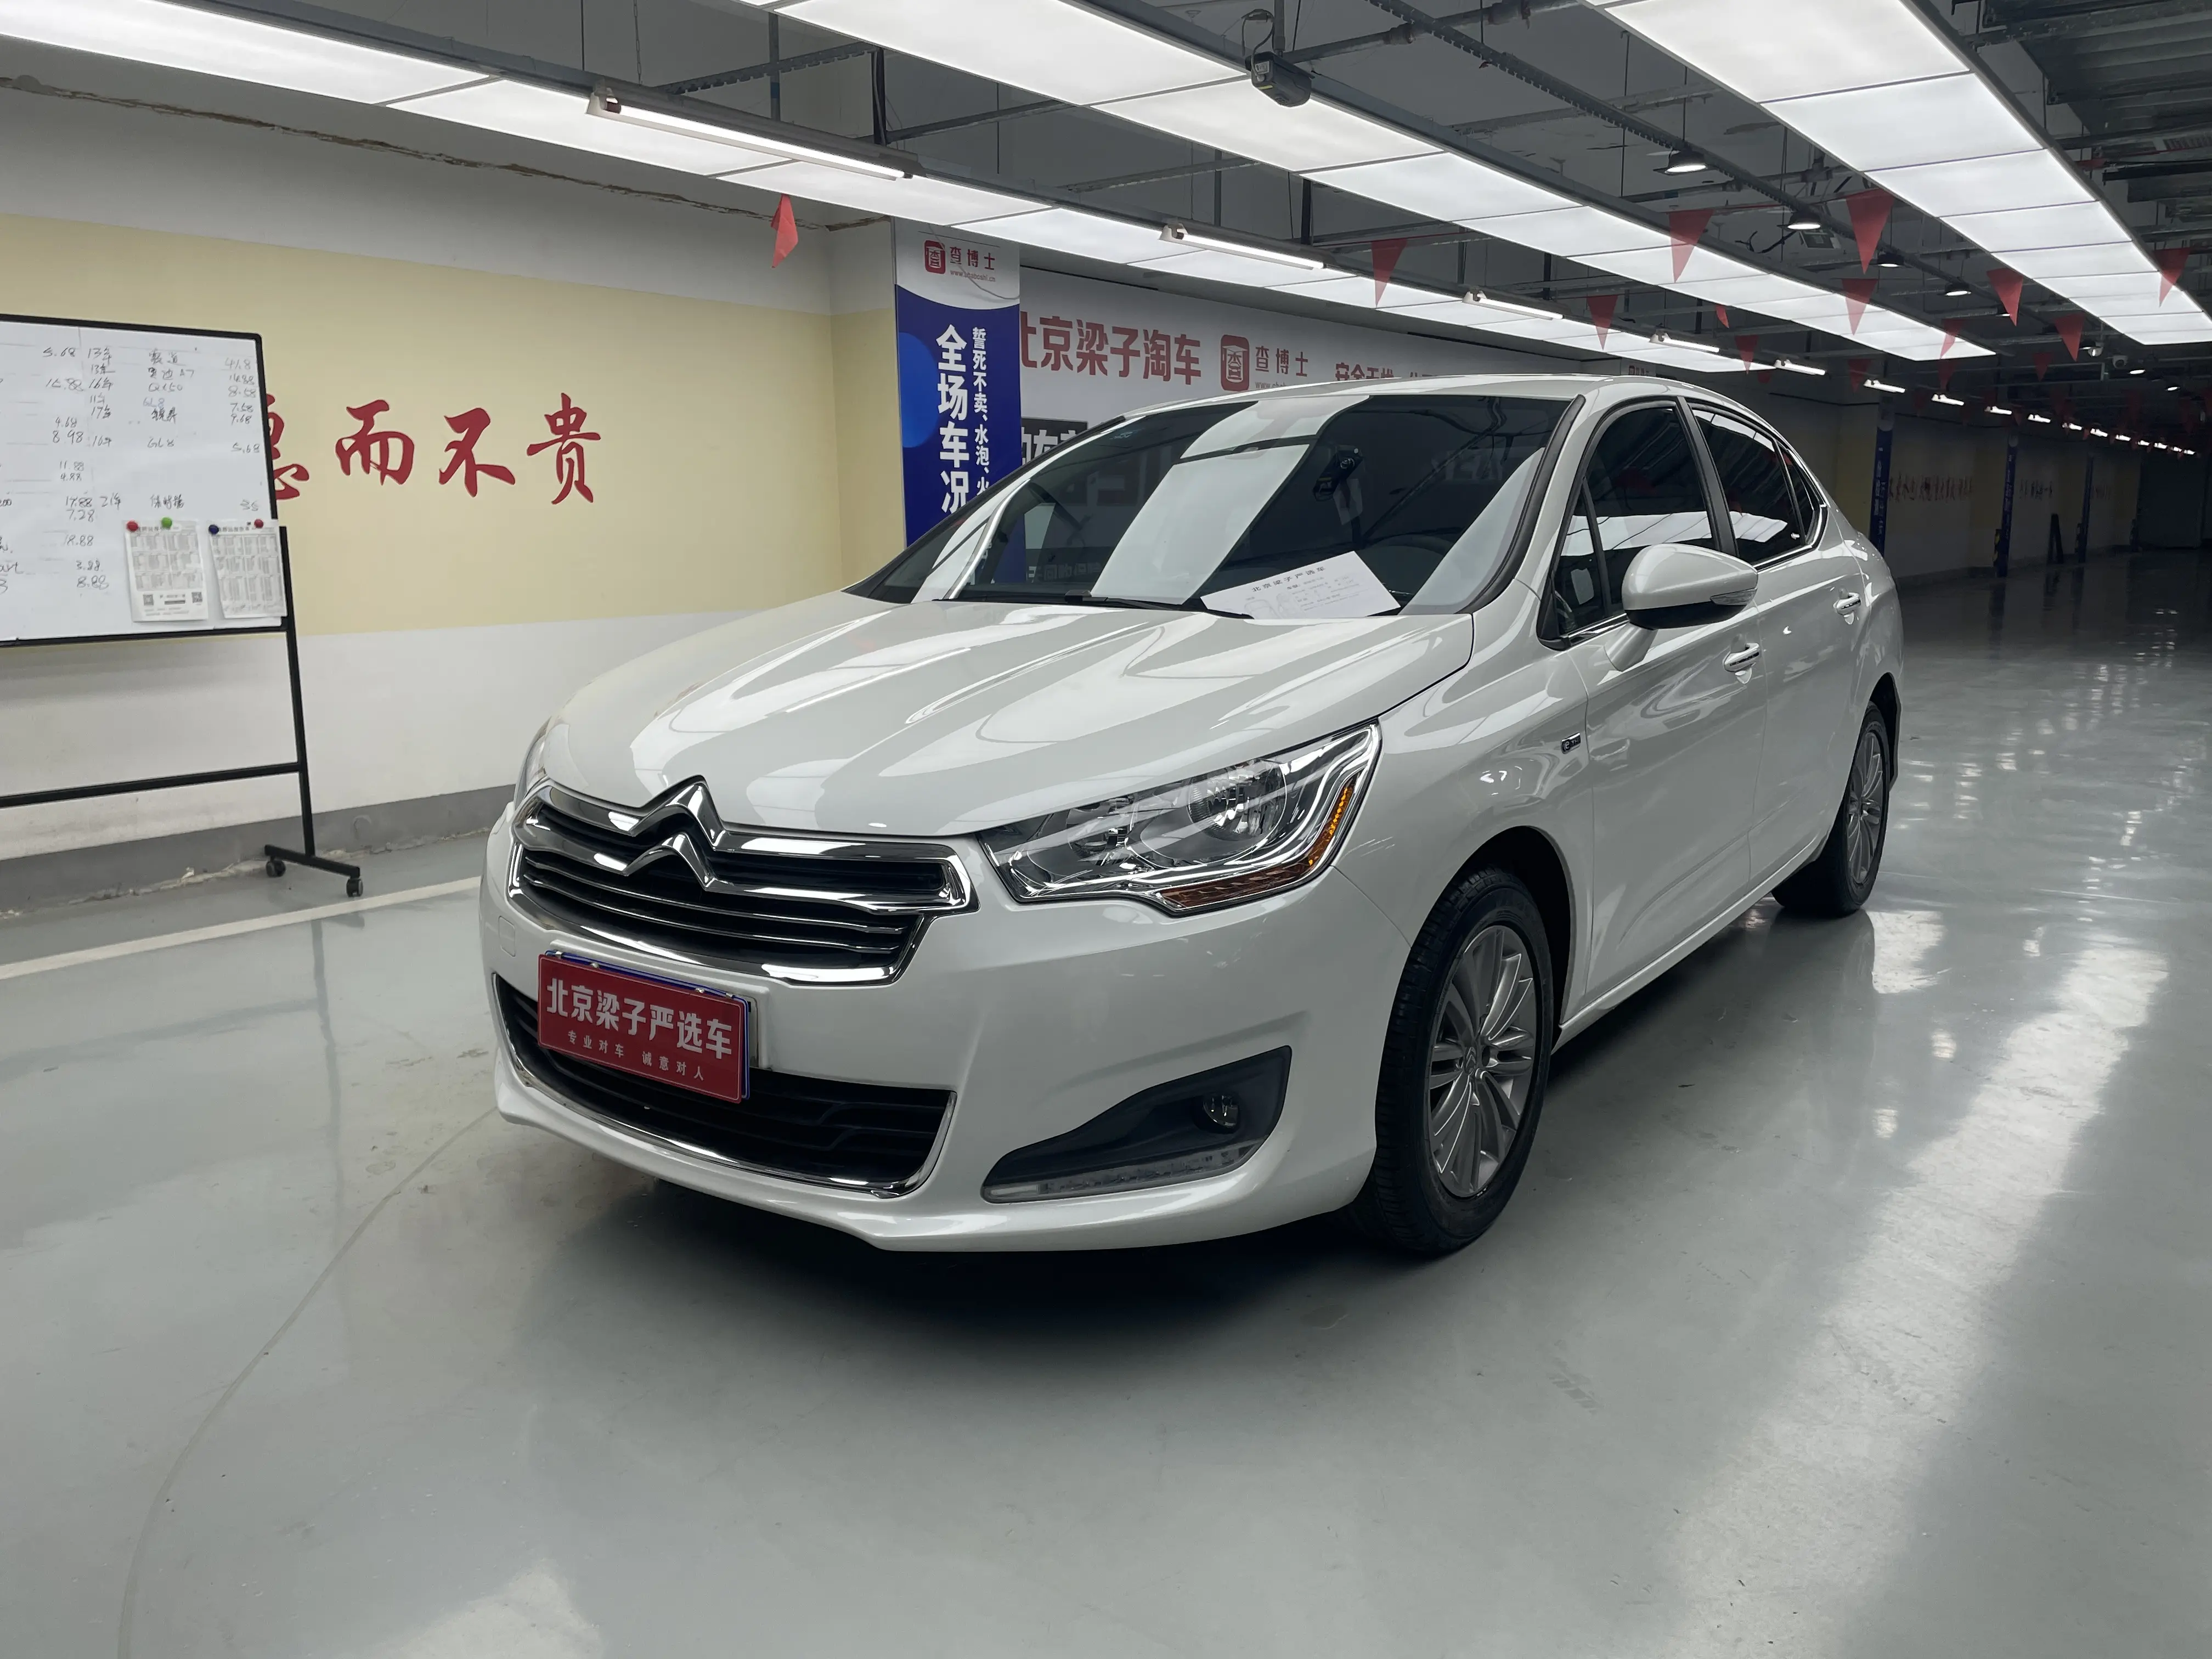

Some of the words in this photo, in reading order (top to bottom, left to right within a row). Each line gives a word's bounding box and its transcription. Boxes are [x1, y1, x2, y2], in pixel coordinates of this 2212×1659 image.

[950, 246, 996, 270] 查博士
[1255, 345, 1308, 377] 查博士
[935, 324, 969, 514] 全场车况
[546, 978, 732, 1059] 北京梁子严选车
[567, 1029, 624, 1058] 专业对车
[641, 1051, 704, 1082] 诚意对人
